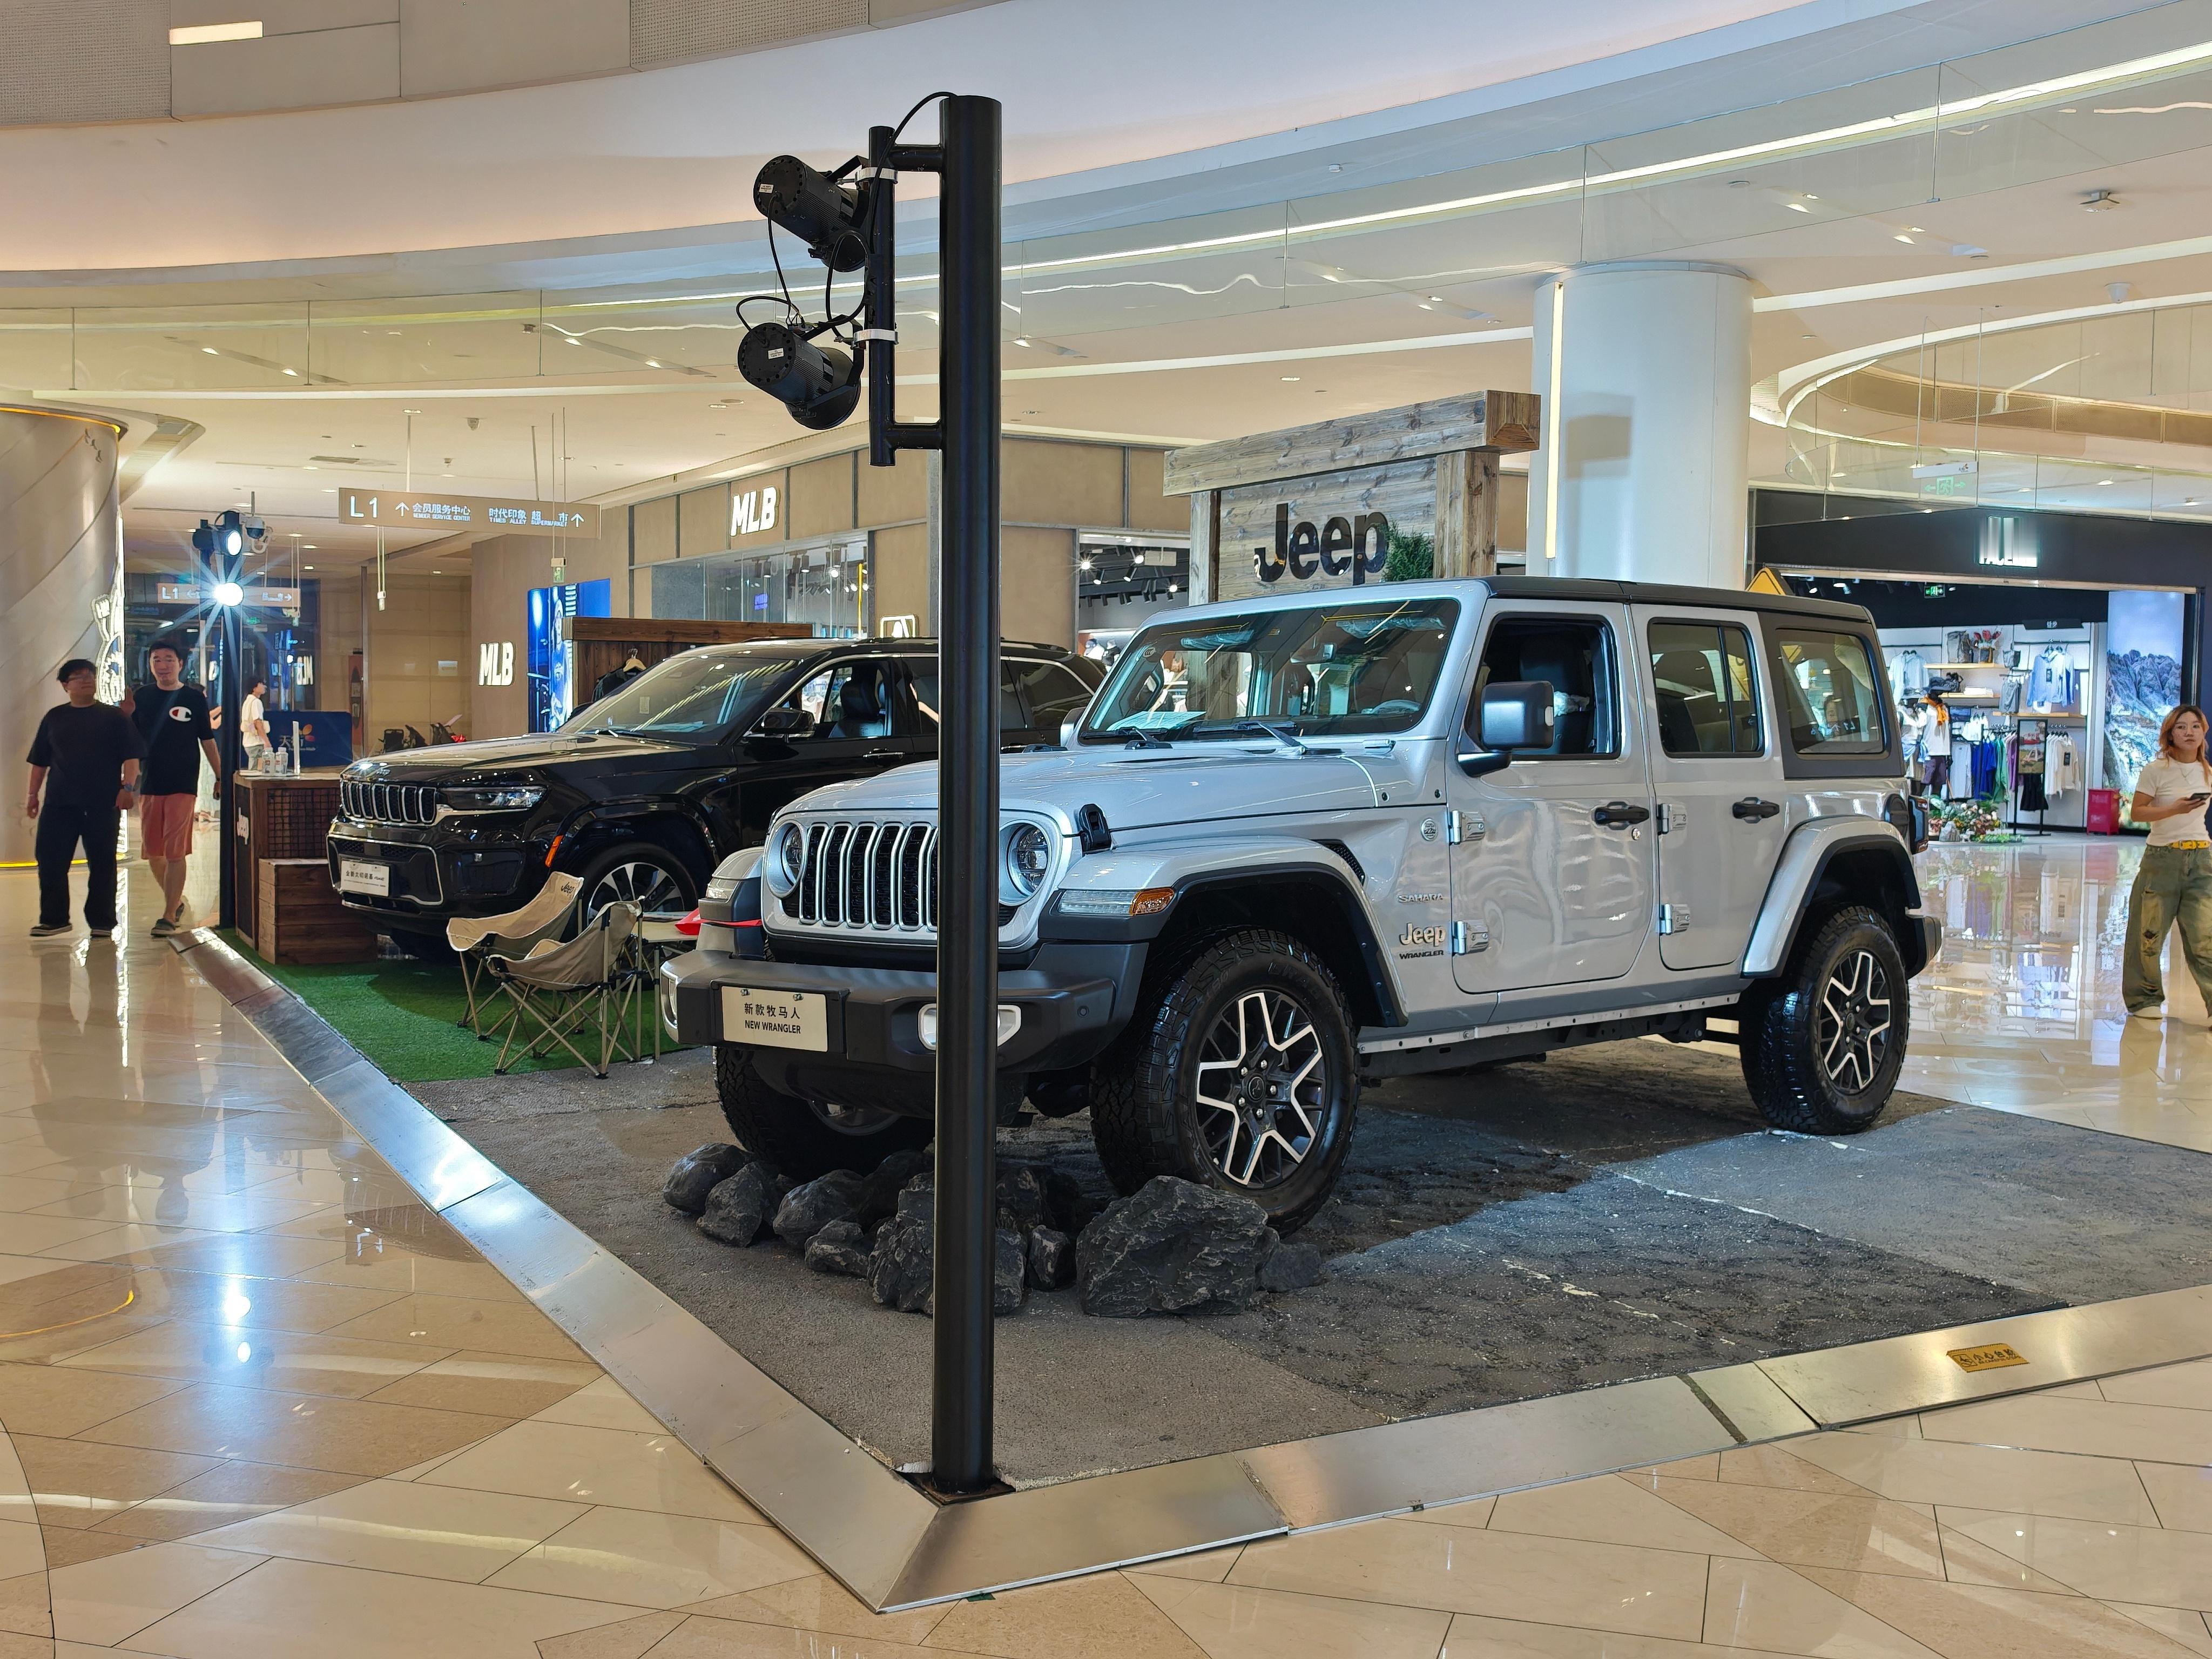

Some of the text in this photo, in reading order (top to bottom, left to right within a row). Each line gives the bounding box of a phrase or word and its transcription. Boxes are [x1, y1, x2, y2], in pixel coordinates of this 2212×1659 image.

[350, 495, 377, 518] L1
[413, 502, 471, 516] 会员服务中心
[489, 508, 527, 520] 时代印象
[730, 485, 778, 537] MLB
[1253, 503, 1389, 586] Jeep
[161, 586, 179, 599] L1
[478, 641, 514, 686] MLB
[1398, 893, 1444, 903] SAHARA
[1399, 922, 1446, 947] Jeep
[1399, 950, 1444, 960] WRANGLER
[744, 1002, 800, 1020] 新款牧马人
[745, 1020, 801, 1034] NEW WRANGLER
